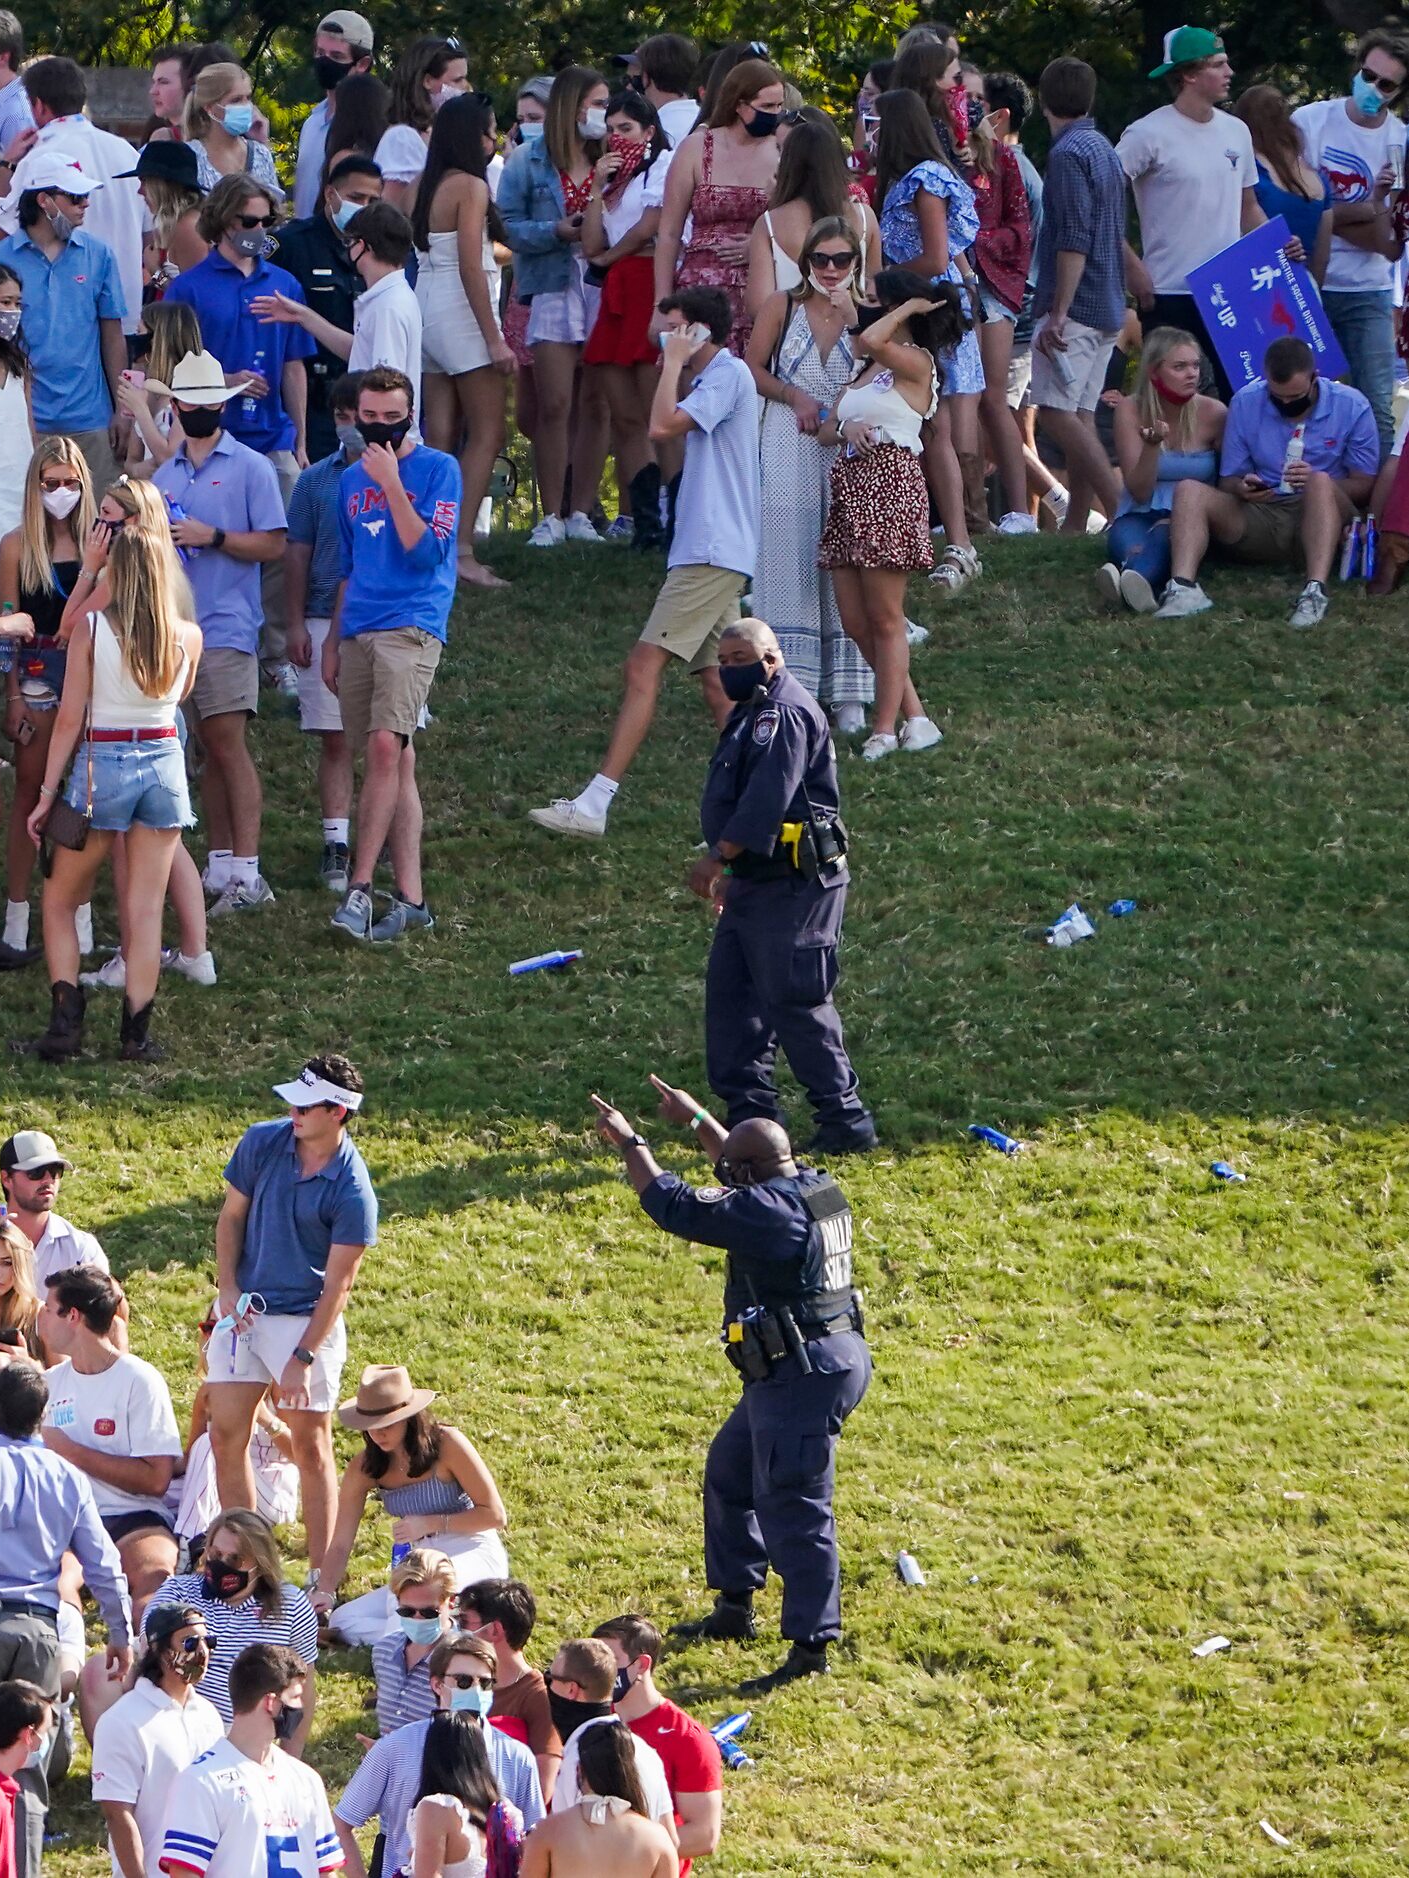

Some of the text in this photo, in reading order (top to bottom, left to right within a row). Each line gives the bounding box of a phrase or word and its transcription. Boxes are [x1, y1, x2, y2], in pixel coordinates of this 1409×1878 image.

[1217, 306, 1238, 329] UP
[1276, 248, 1327, 353] PRACTICE SOCIAL DISTANCING
